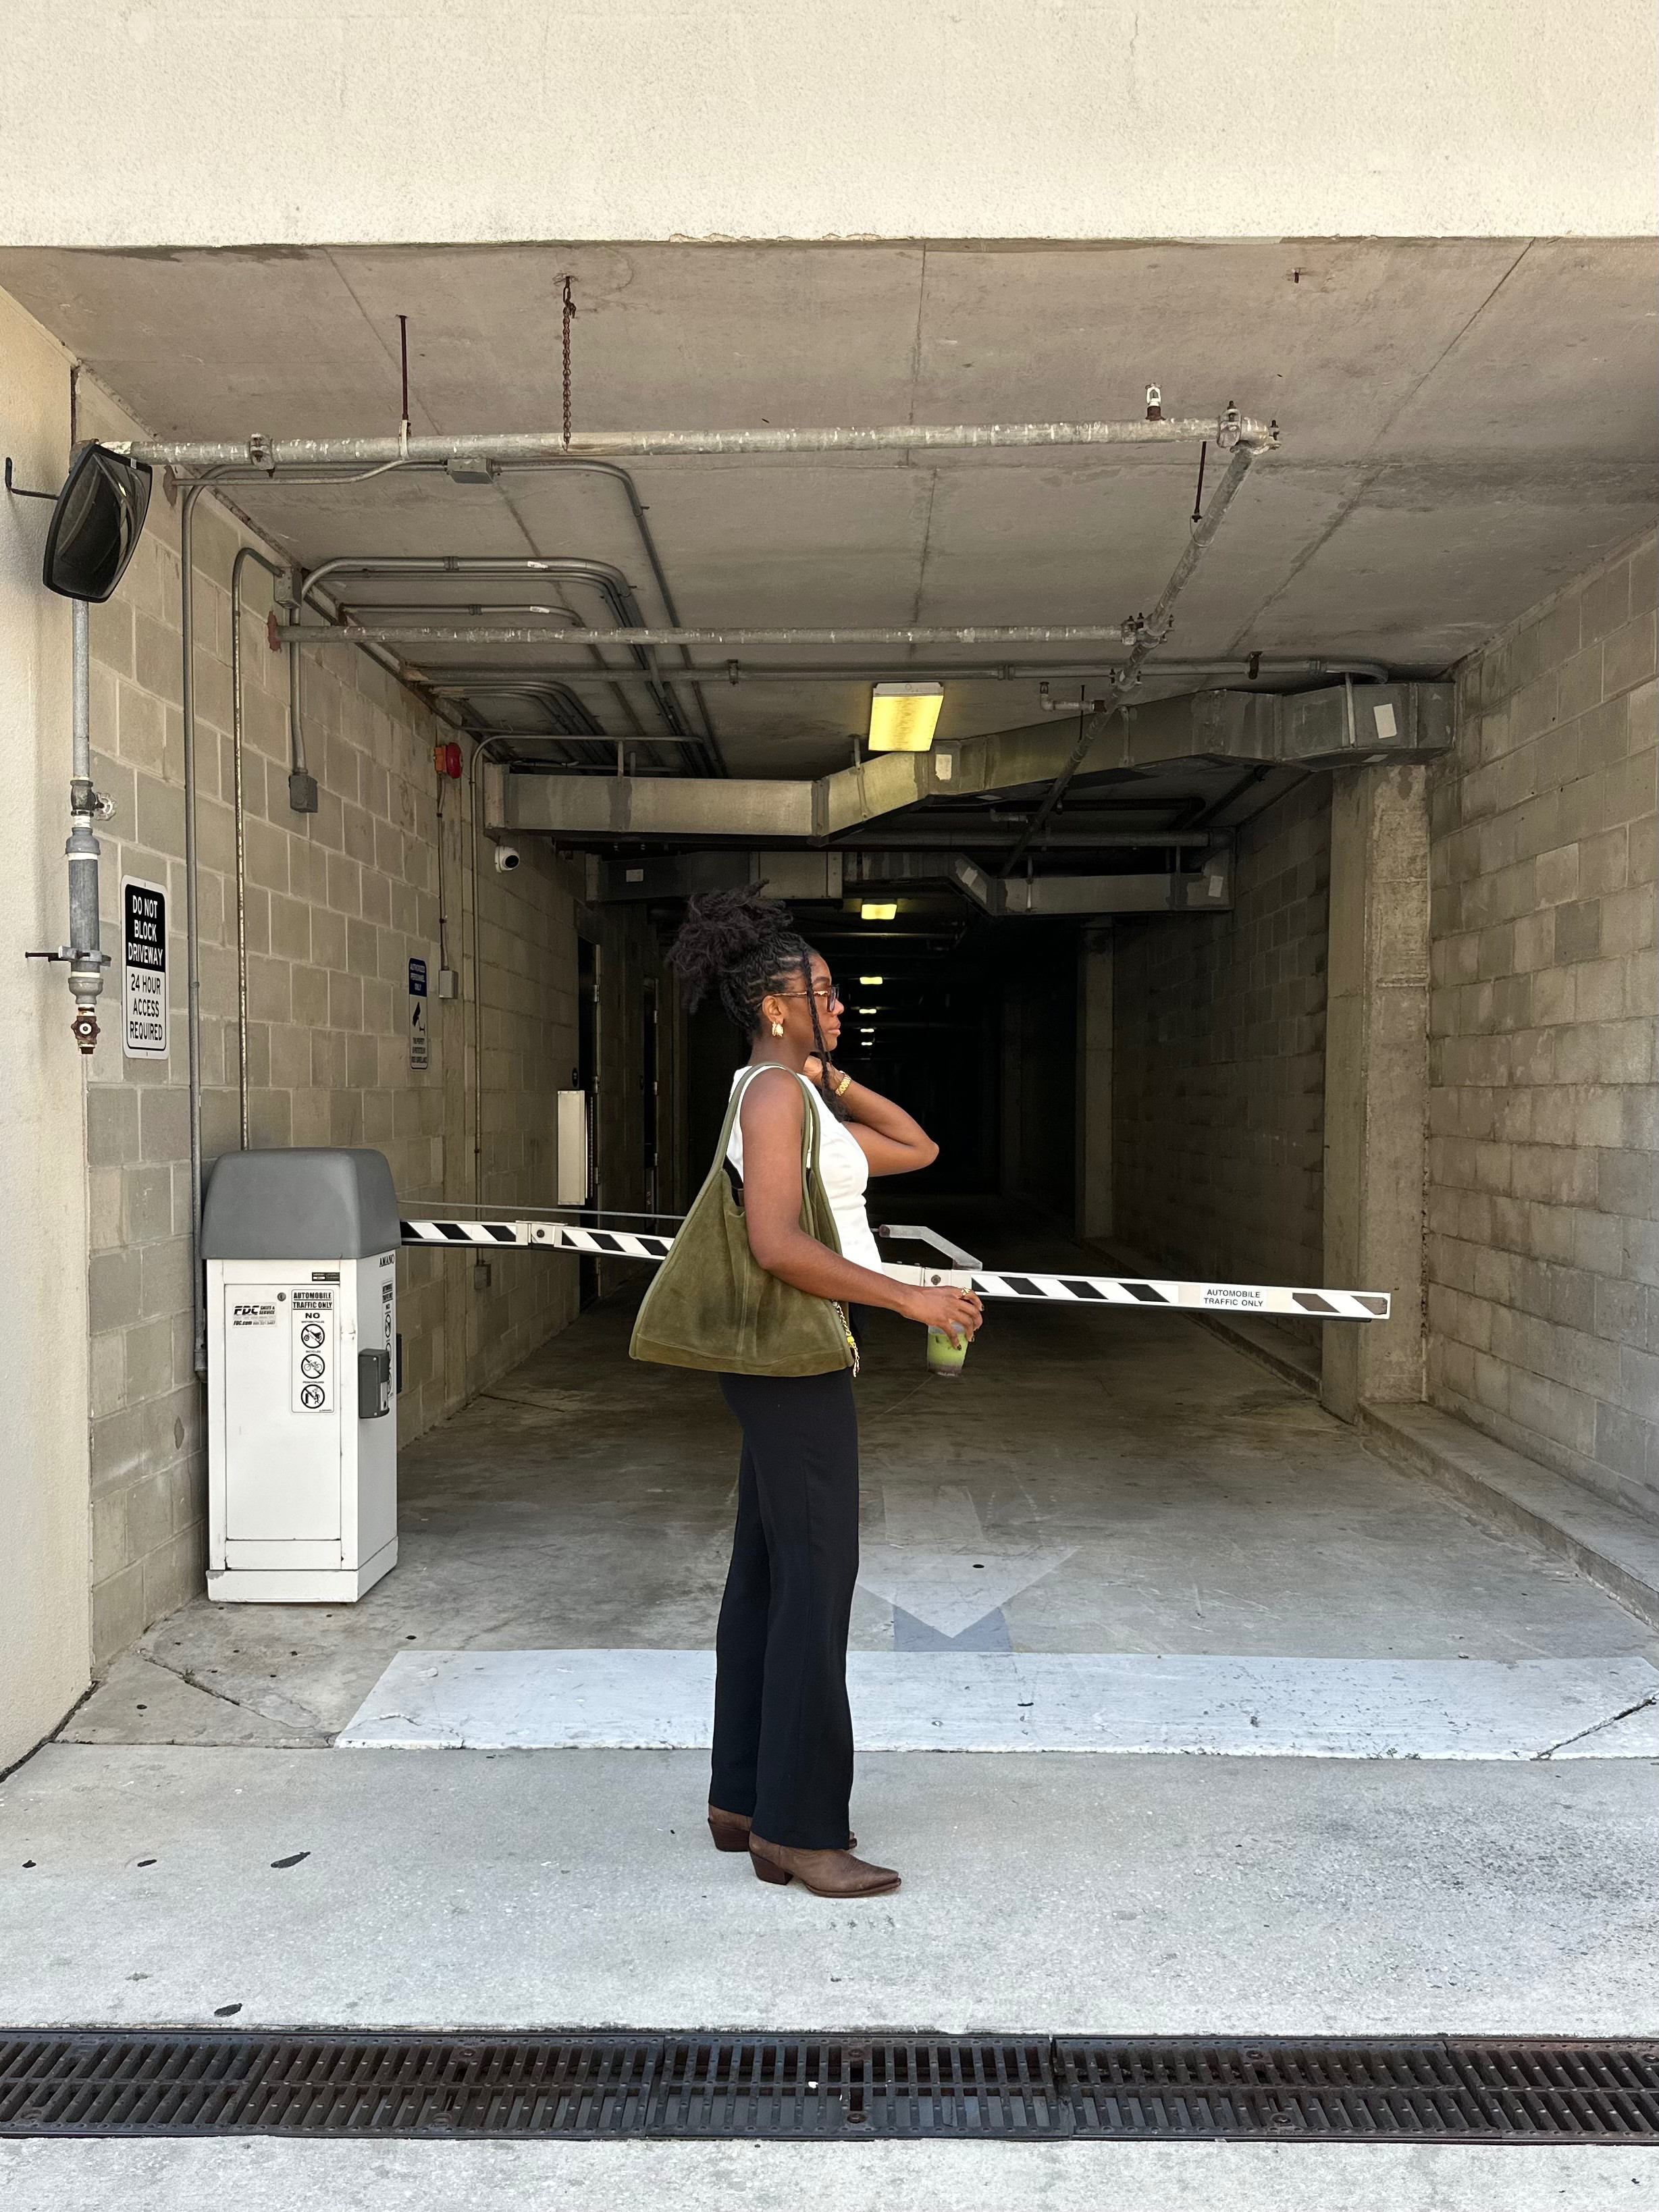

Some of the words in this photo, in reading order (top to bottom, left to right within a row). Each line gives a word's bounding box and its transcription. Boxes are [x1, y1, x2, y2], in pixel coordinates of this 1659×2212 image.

[132, 895, 142, 914] DO
[144, 898, 158, 919] NOT
[134, 919, 157, 942] BLOCK
[128, 942, 163, 966] DRIVEWAY
[131, 973, 140, 991] 24
[142, 976, 161, 995] HOUR
[133, 997, 159, 1018] ACCESS
[130, 1020, 163, 1041] REQUIRED
[1204, 1297, 1238, 1306] TRAFFIC
[1207, 1289, 1260, 1298] AUTOMOBILE
[234, 1305, 259, 1315] FDC
